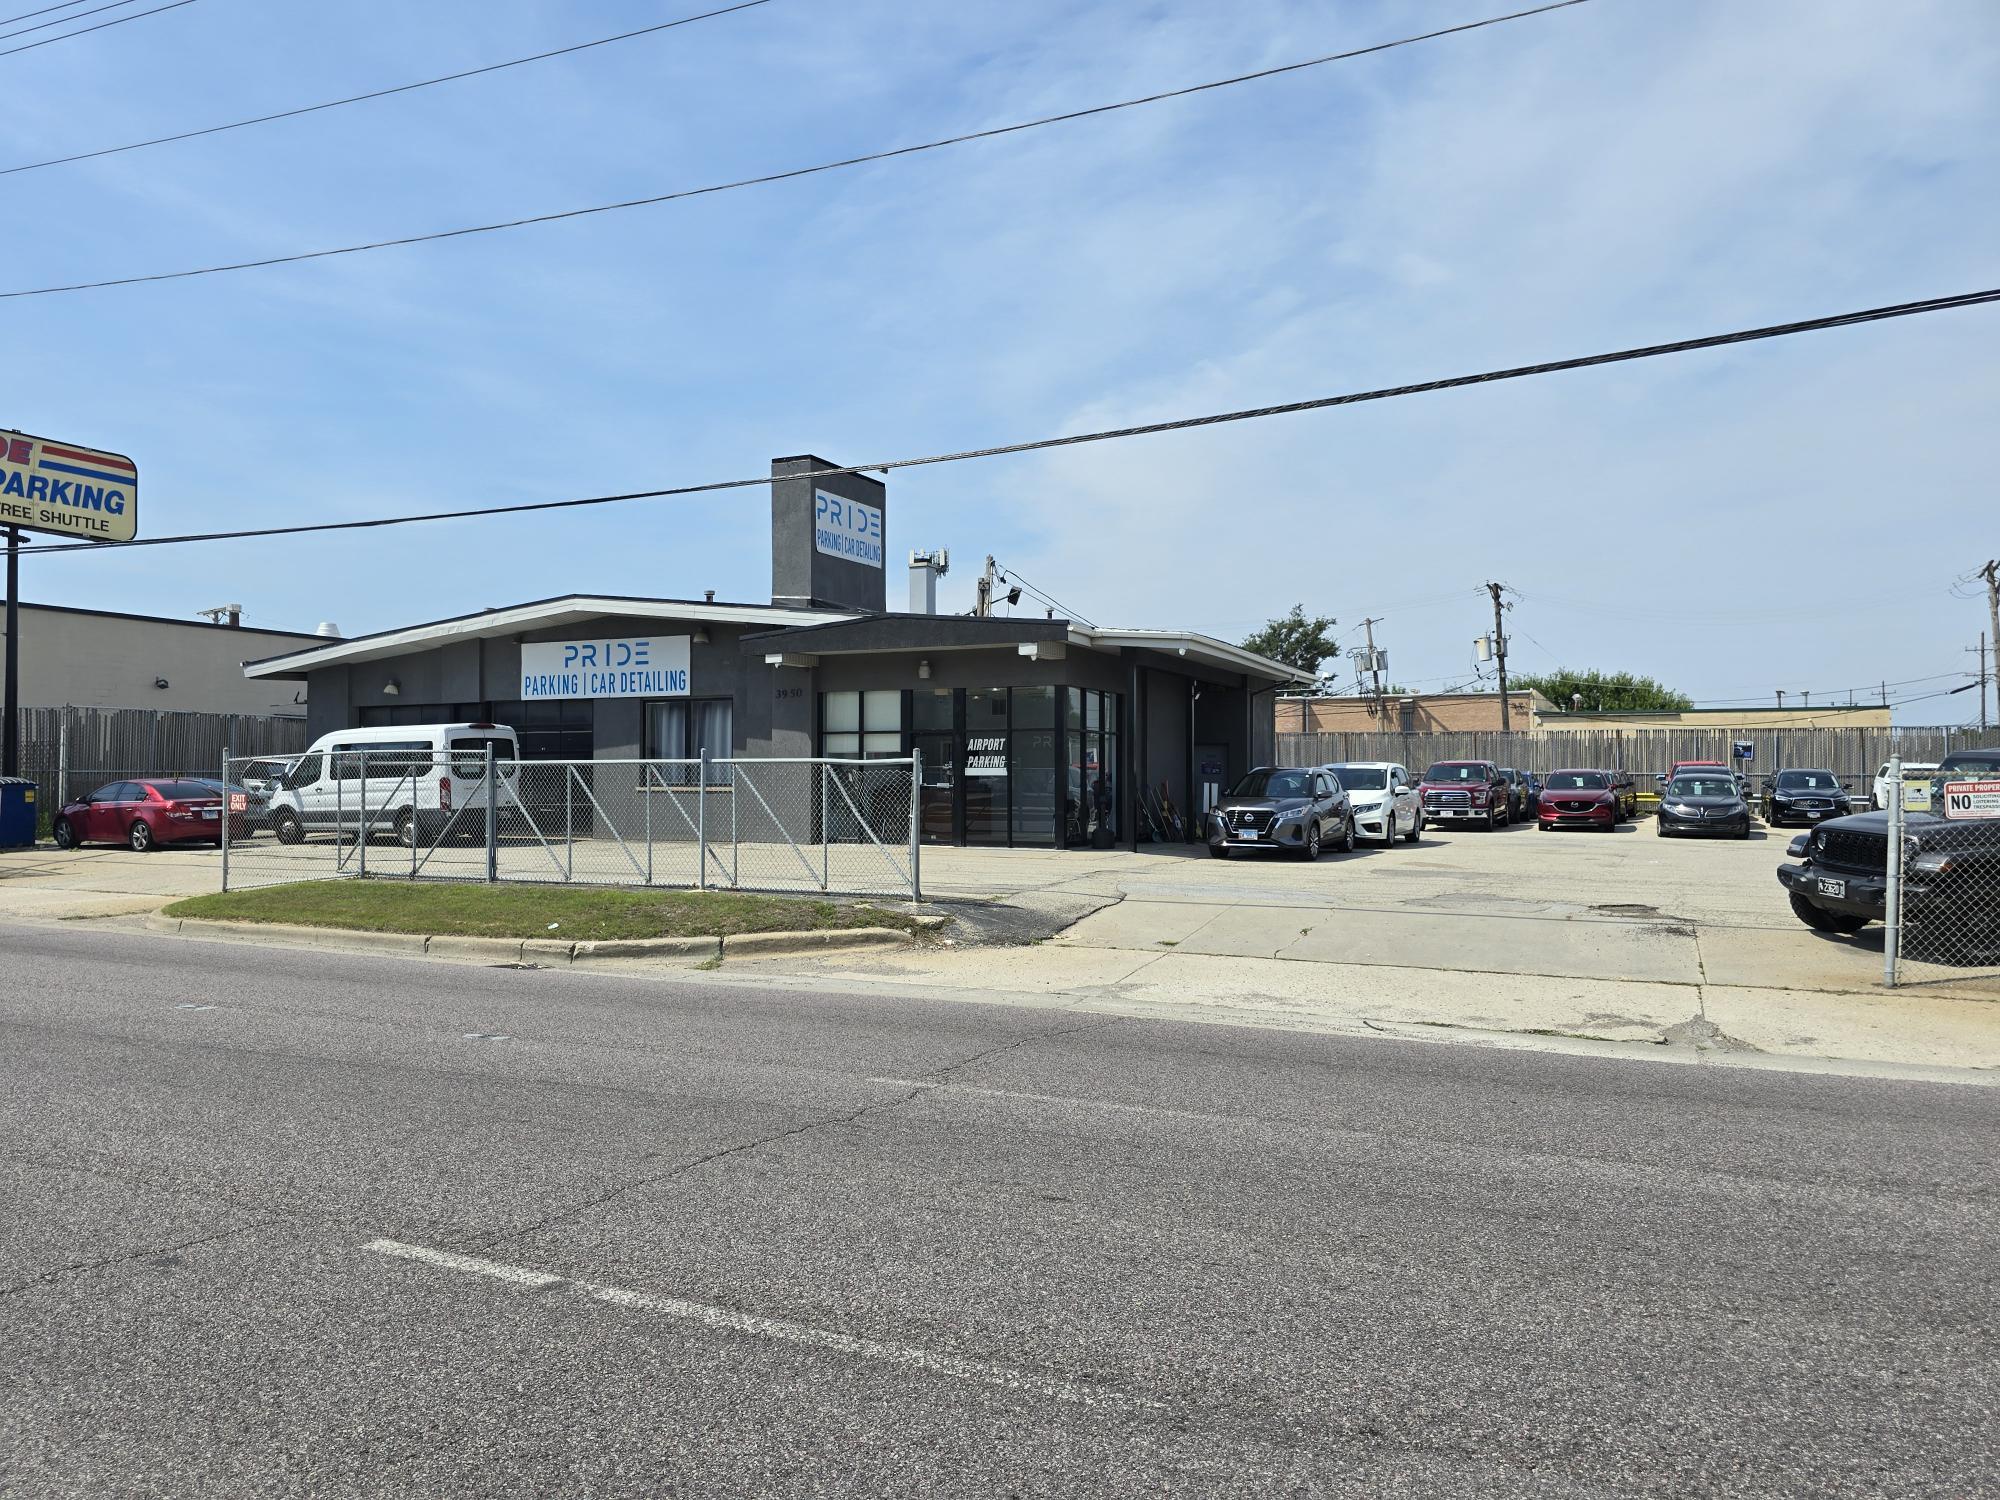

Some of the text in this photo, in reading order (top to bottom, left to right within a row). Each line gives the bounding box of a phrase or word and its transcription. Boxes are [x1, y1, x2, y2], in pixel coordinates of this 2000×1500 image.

[0, 502, 110, 532] REE SHUTTLE
[817, 495, 880, 538] PRIDE
[817, 529, 881, 562] PARKING CAR DETAILING
[564, 641, 650, 669] PRIDE
[525, 669, 687, 696] PARKING CAR DETAILING
[967, 738, 1006, 751] AIRPORT
[967, 755, 1006, 768] PARKING
[1948, 784, 1974, 793] PRIVATE
[231, 794, 246, 803] EXIT
[1951, 795, 1971, 810] NO
[230, 802, 247, 811] ONLY
